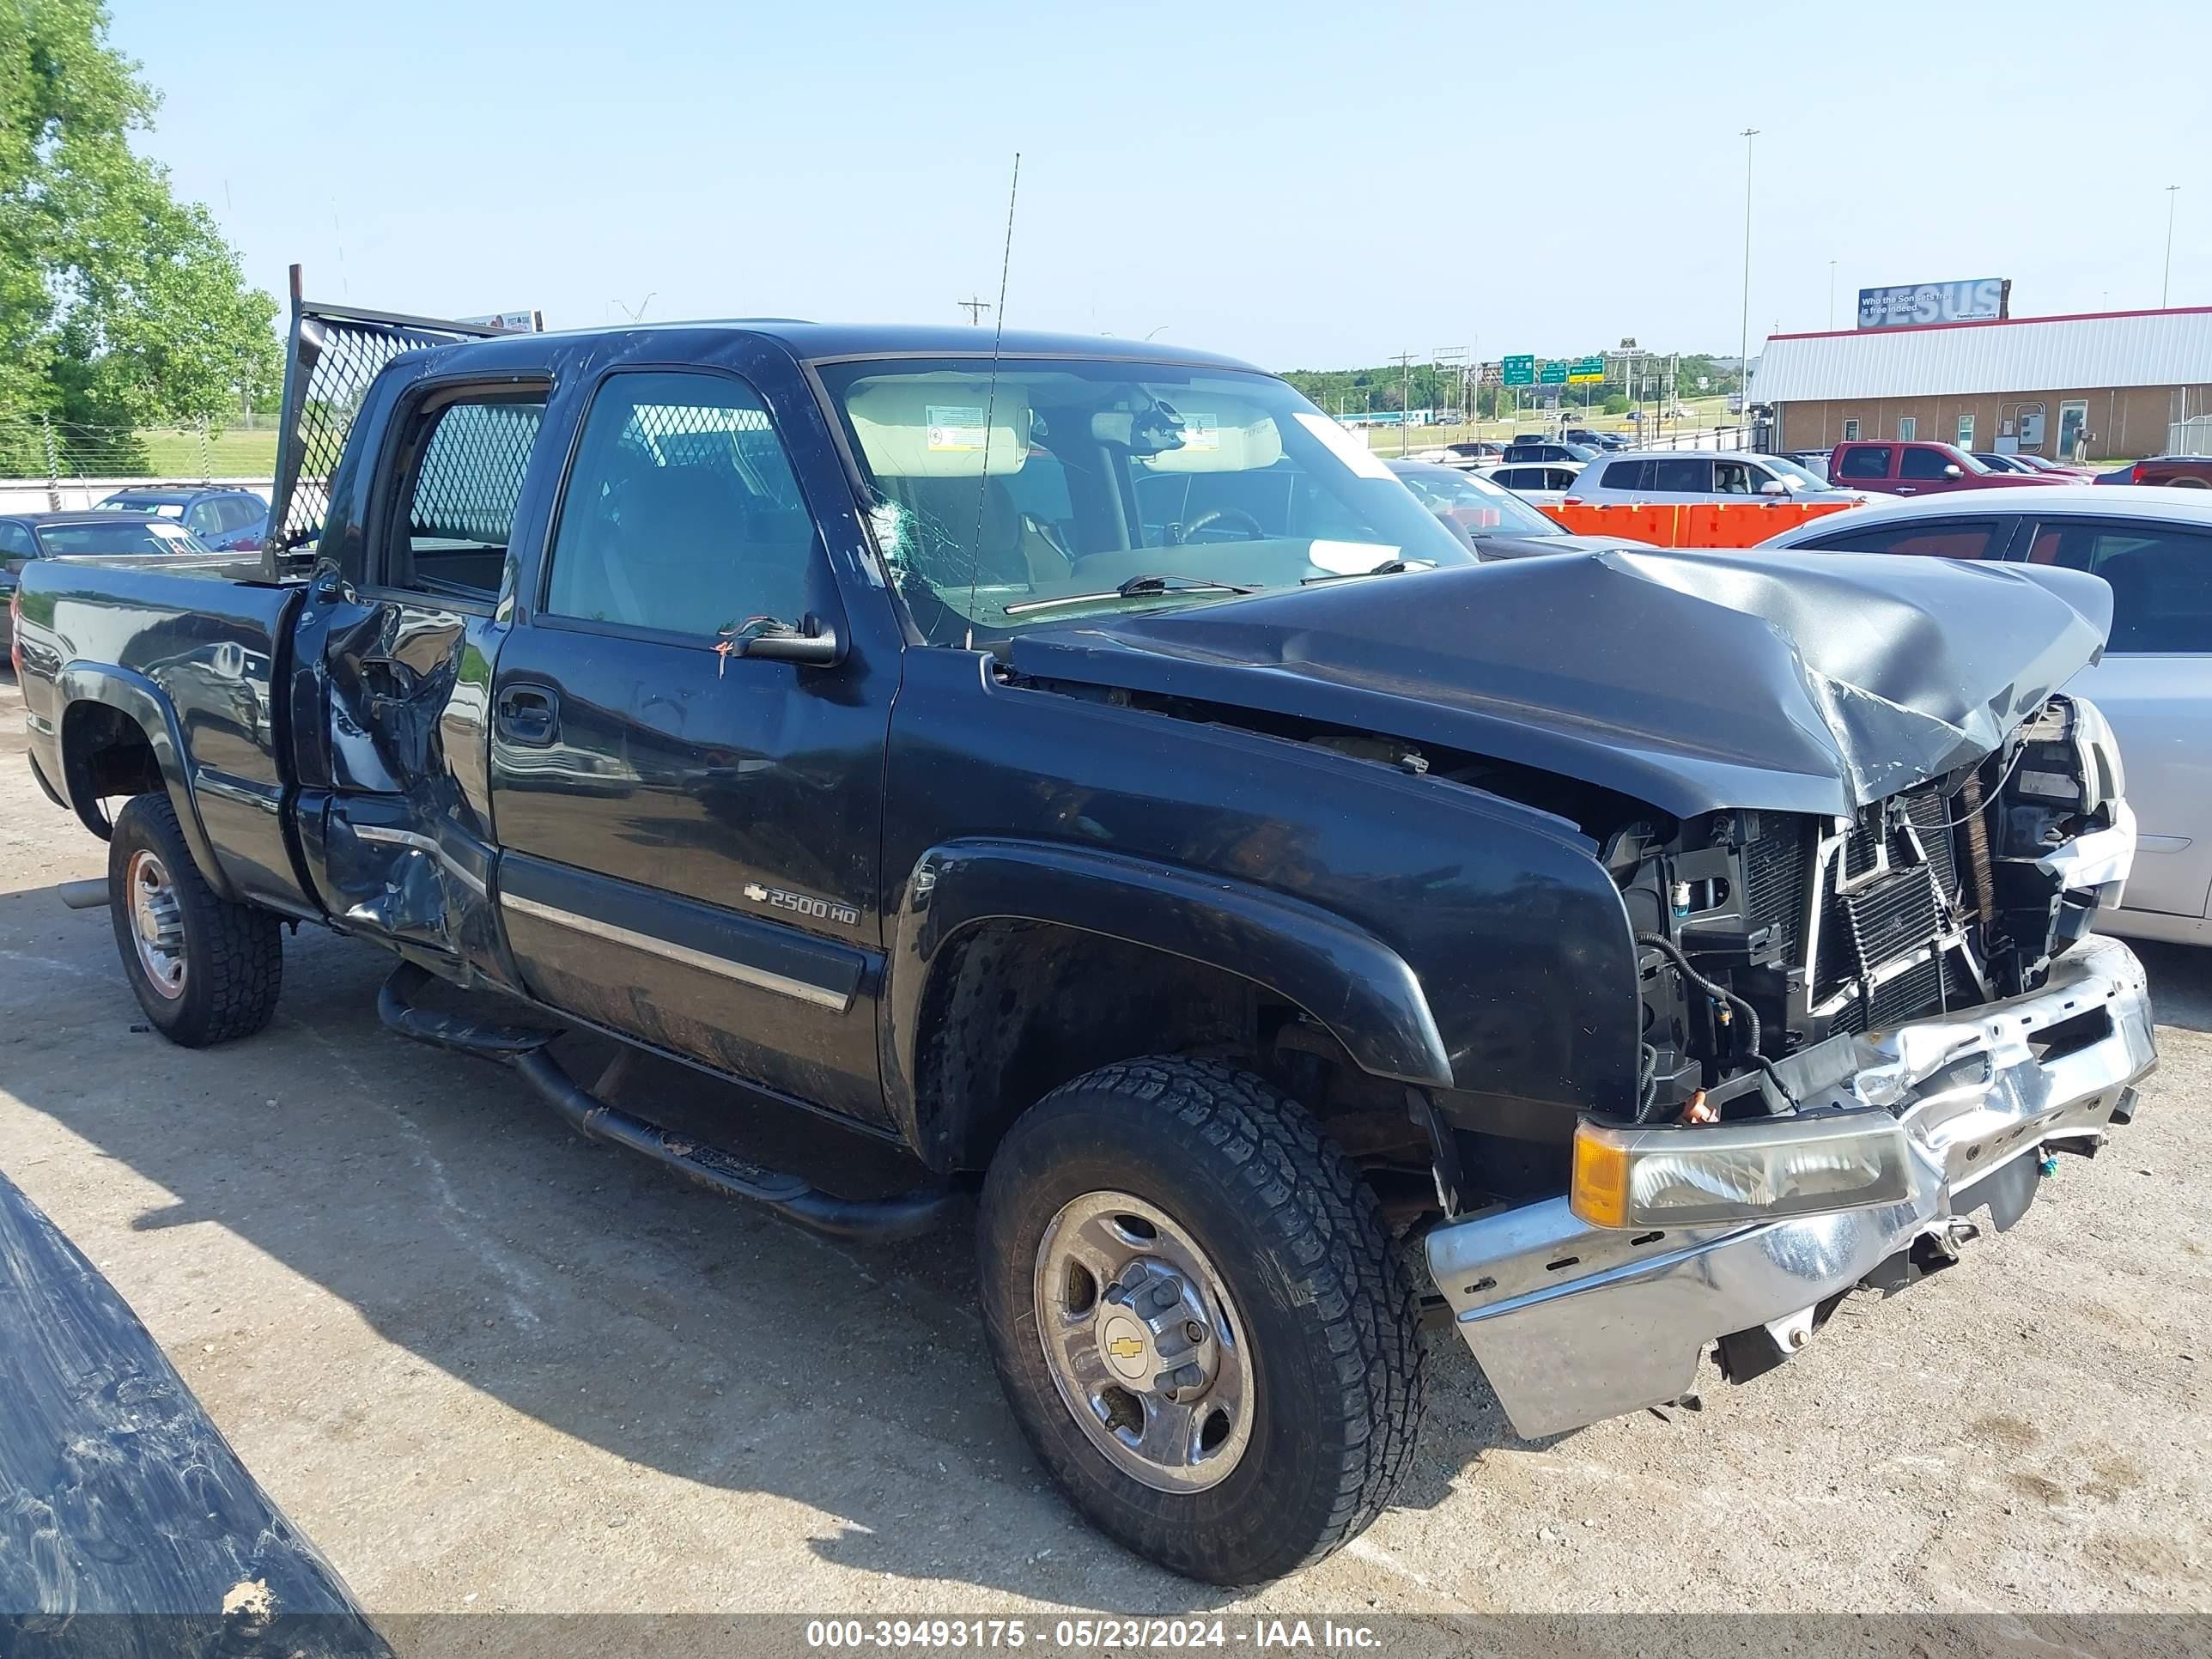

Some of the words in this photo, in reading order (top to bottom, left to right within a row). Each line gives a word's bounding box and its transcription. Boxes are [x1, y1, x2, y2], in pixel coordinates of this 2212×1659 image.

[1859, 279, 2001, 327] JESUS
[1862, 297, 1881, 306] Who
[1882, 295, 1896, 305] the
[1898, 294, 1915, 304] Son
[1916, 293, 1935, 302] sets
[1861, 307, 1869, 315] is
[1870, 306, 1887, 315] free
[319, 582, 336, 592] LS
[770, 891, 829, 918] 2500
[830, 907, 858, 925] HD
